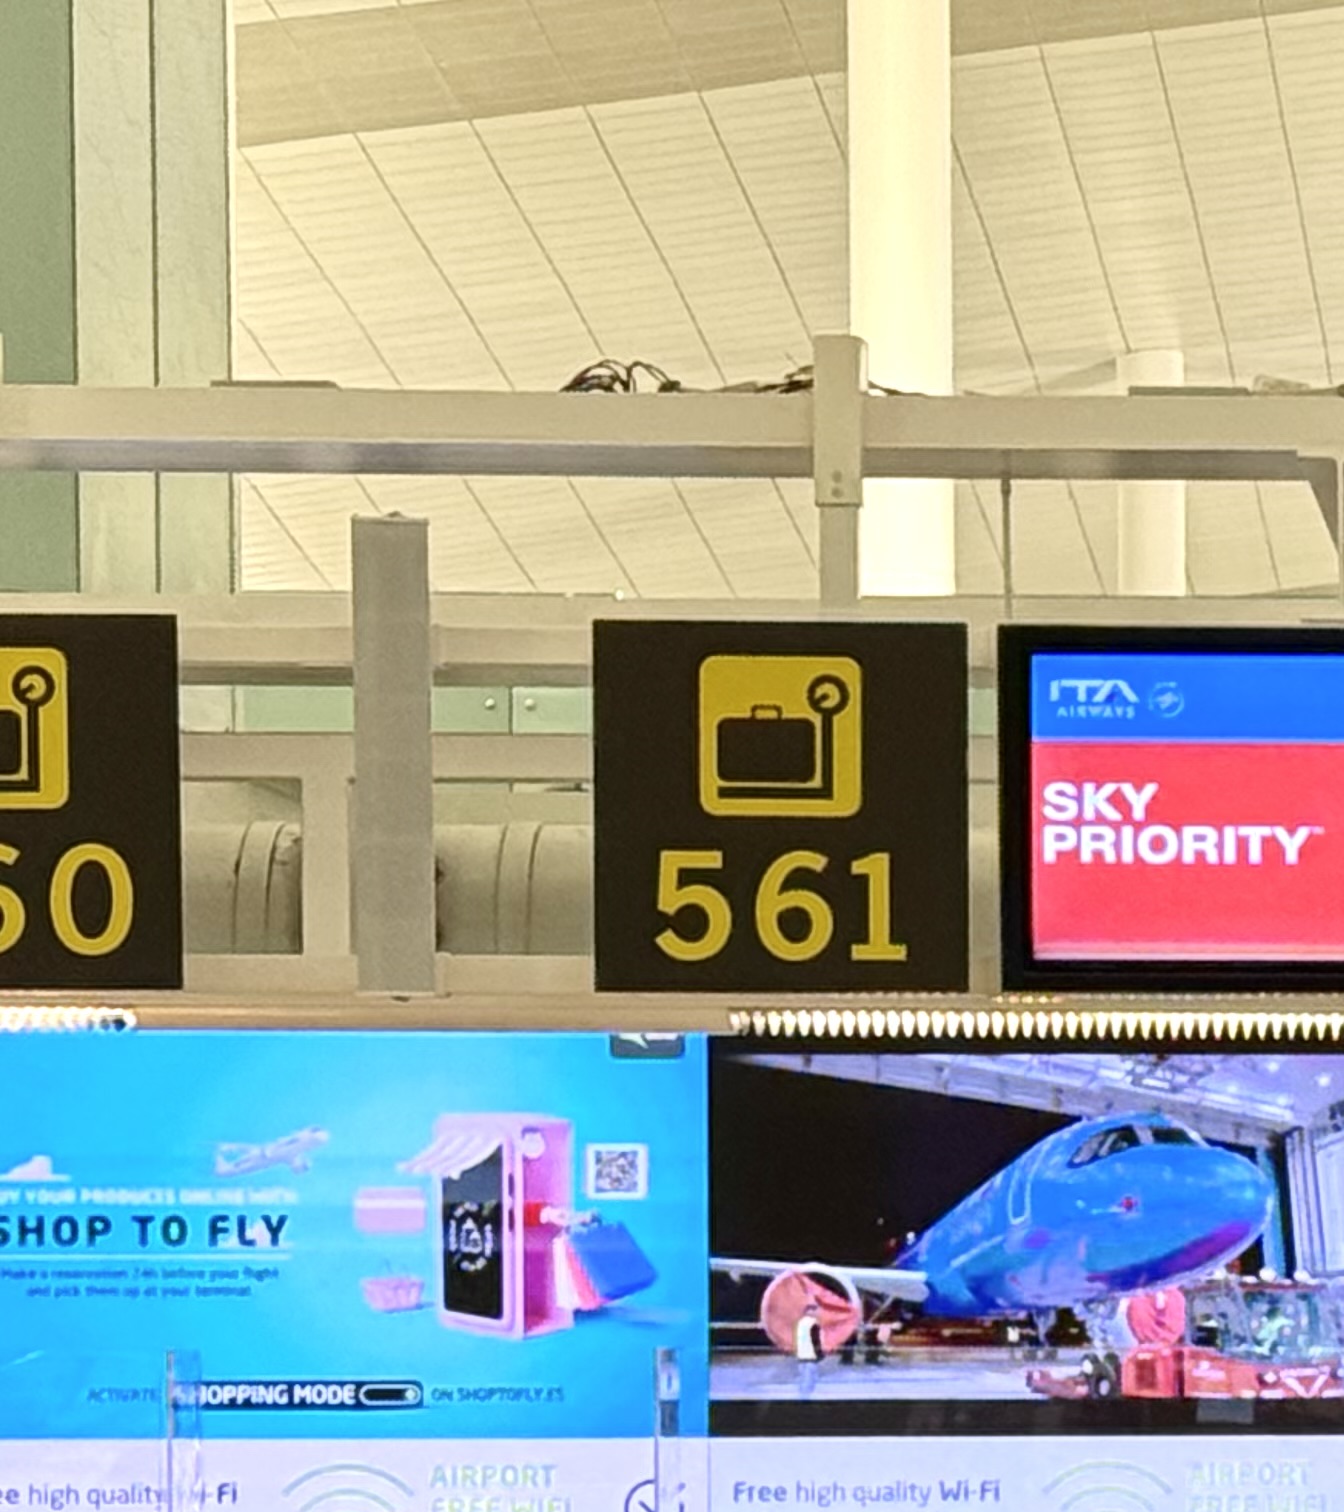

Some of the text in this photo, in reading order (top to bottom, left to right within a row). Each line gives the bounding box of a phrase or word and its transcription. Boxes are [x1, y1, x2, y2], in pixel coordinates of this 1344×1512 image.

[1050, 679, 1140, 703] ITA
[1056, 704, 1136, 720] AIRWAYS
[1042, 781, 1159, 822] SKY
[655, 850, 907, 962] 561
[131, 1214, 188, 1248] TO
[208, 1214, 289, 1248] FLY
[294, 1384, 356, 1405] MODE
[430, 1464, 558, 1488] AIRPORT
[1187, 1461, 1313, 1486] AIRPORT
[29, 1482, 80, 1511] high
[733, 1479, 1000, 1507] Free high quality Wi-Fi
